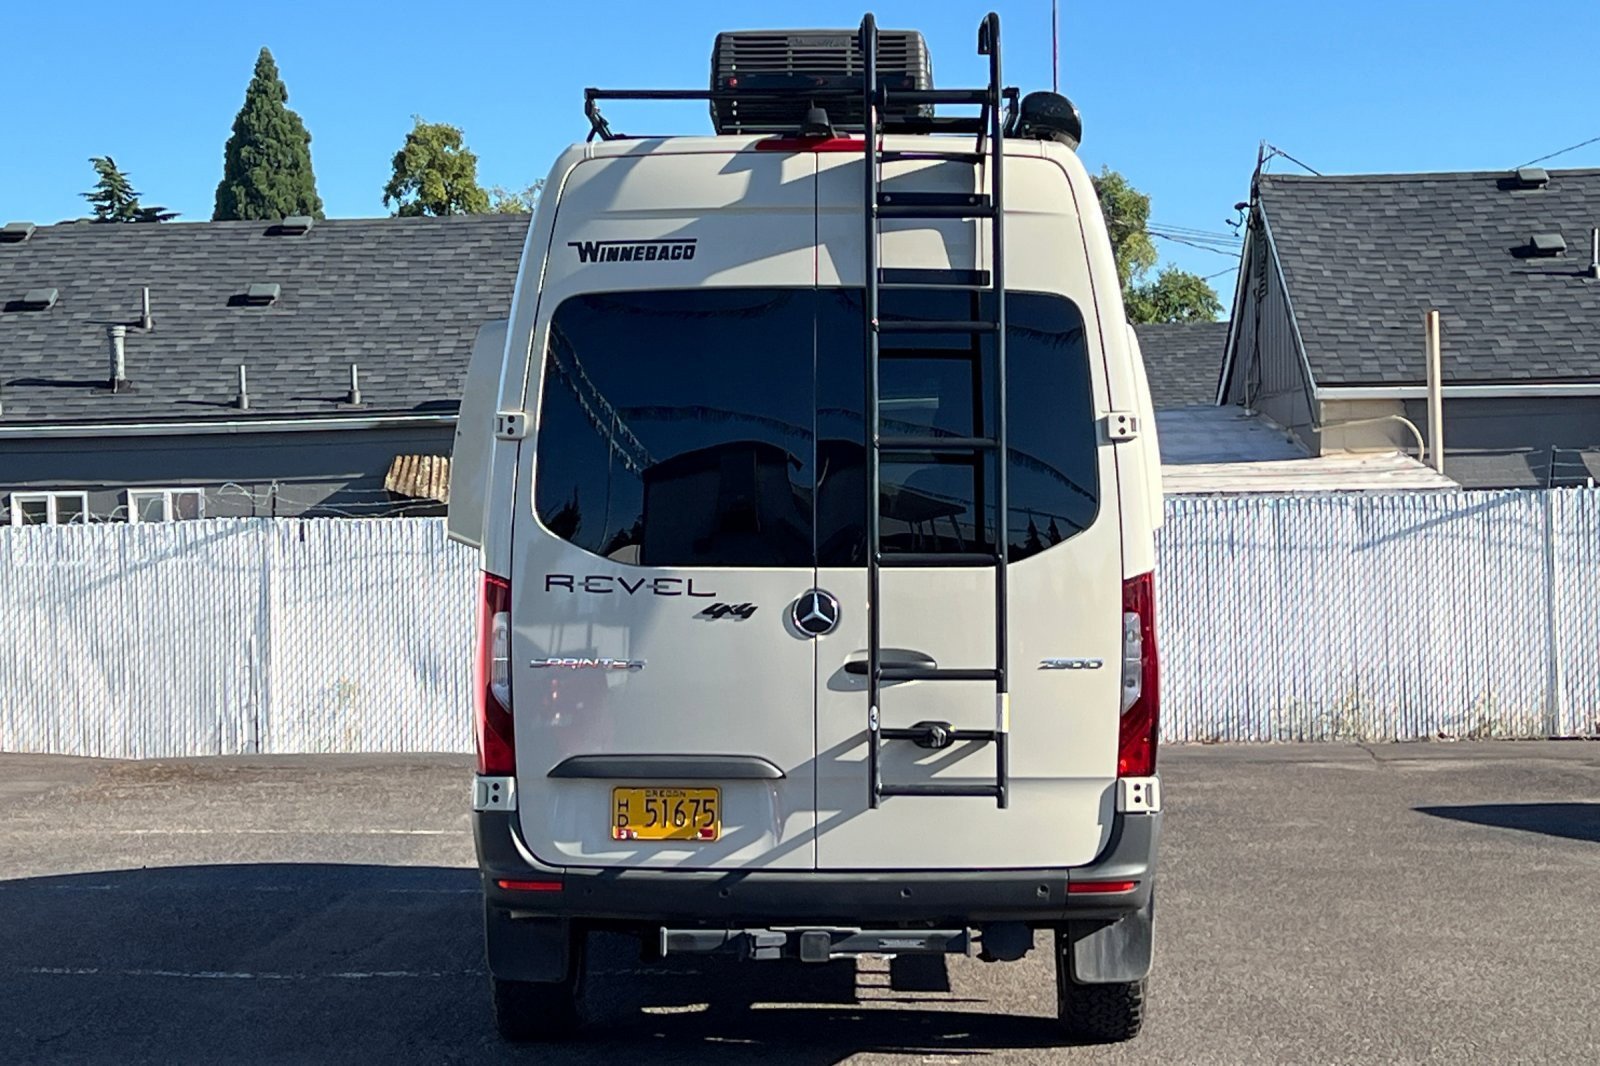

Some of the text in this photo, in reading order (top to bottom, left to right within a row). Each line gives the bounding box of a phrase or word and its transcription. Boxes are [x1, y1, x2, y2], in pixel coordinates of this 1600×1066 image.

[576, 240, 697, 263] WINNEBAGO
[545, 574, 716, 597] REVEL
[645, 790, 686, 798] OREGON
[645, 799, 715, 828] 51675
